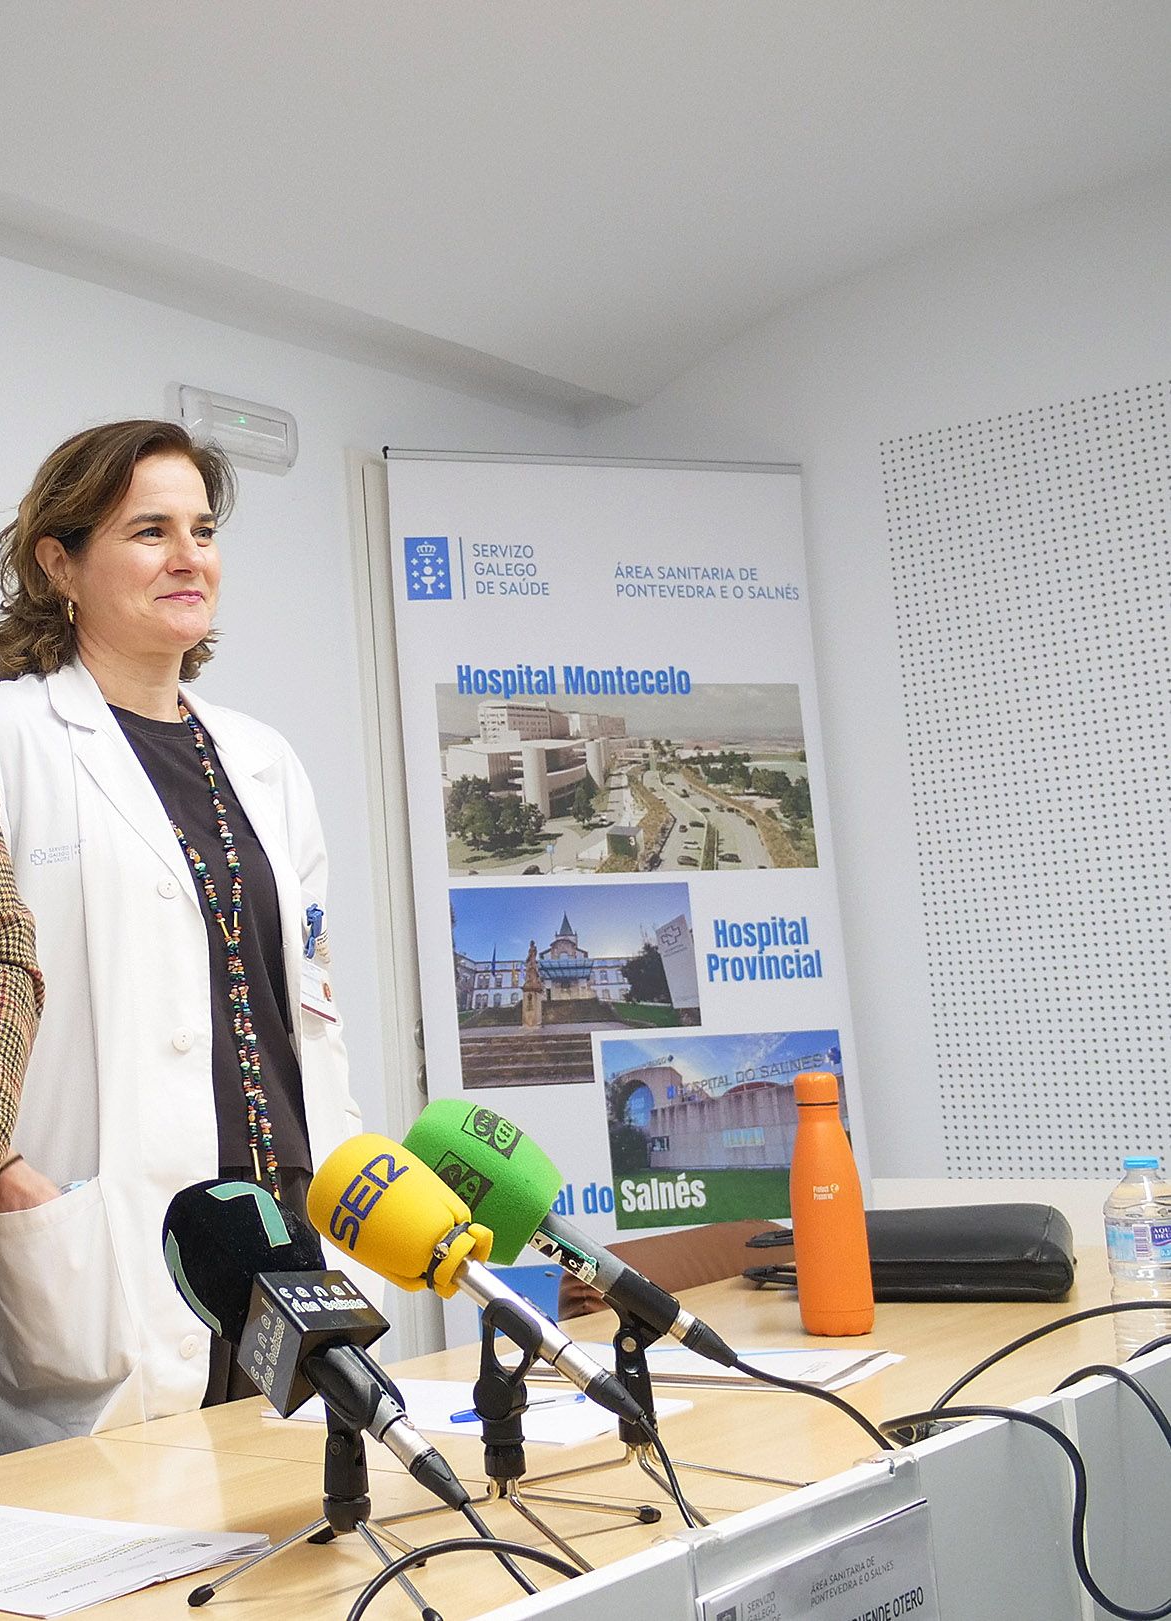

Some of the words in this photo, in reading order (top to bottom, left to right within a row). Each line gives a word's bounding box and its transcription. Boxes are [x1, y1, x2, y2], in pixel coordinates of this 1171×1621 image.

[472, 543, 534, 559] SERVIZO
[474, 561, 537, 577] GALEGO
[614, 562, 653, 579] ÁREA
[657, 566, 736, 581] SANITARIA
[739, 567, 758, 581] DE
[475, 580, 495, 595] DE
[499, 577, 550, 596] SAÚDE
[616, 584, 716, 599] PONTEVEDRA
[720, 585, 729, 598] E
[732, 585, 744, 599] O
[748, 583, 800, 600] SALNÉS
[456, 664, 556, 699] Hospital
[564, 665, 691, 695] Montecelo
[713, 916, 809, 956] Hospital
[706, 949, 823, 983] Provincial
[736, 1068, 756, 1083] DO
[329, 1153, 409, 1251] SER
[582, 1182, 614, 1215] do
[620, 1173, 707, 1212] Salnés
[279, 1281, 358, 1299] canal
[250, 1297, 274, 1380] canal
[892, 1586, 924, 1617] OTERO
